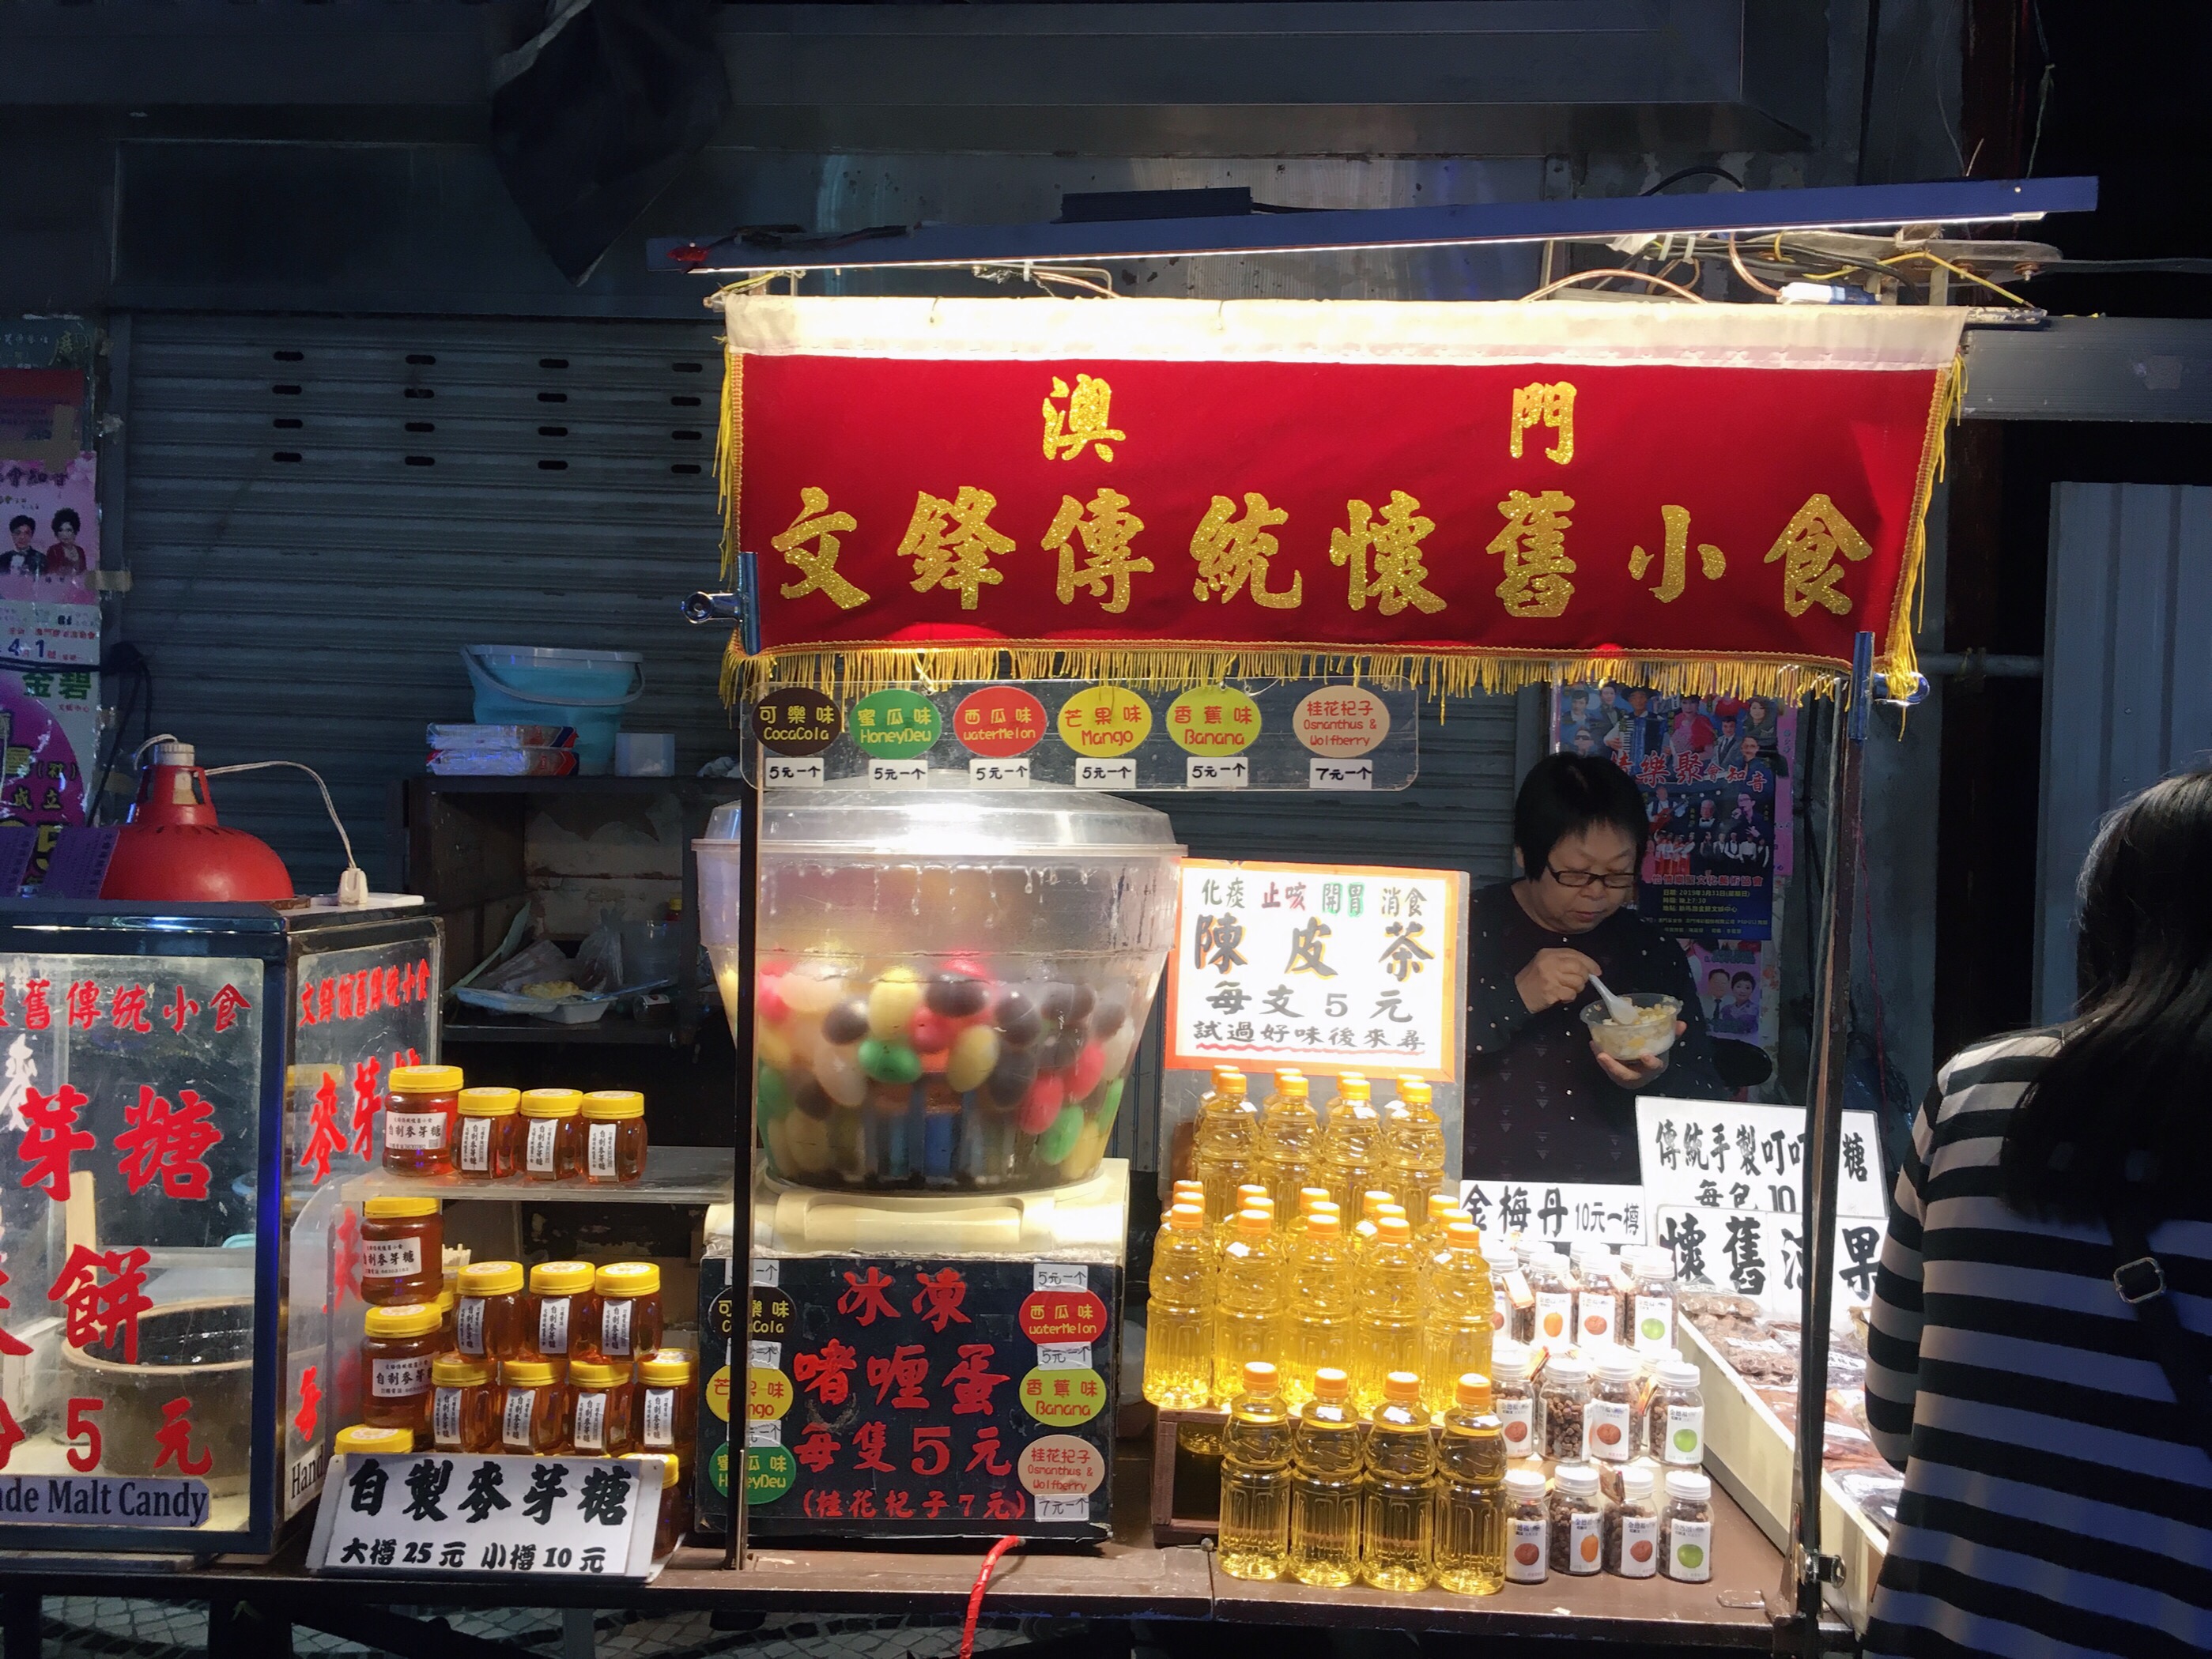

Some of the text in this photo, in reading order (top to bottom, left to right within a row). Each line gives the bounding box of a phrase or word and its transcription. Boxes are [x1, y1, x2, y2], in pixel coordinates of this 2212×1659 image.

[1042, 374, 1577, 465] 澳門
[771, 486, 1873, 618] 文鋒傳統懷舊小食
[760, 706, 834, 724] 可樂味
[858, 708, 931, 726] 蜜瓜味
[964, 707, 1032, 725] 西瓜味
[1065, 704, 1142, 728] 芒果味
[1174, 705, 1253, 725] 香蕉味
[764, 727, 829, 740] CocaCola
[964, 727, 1036, 740] waterMelon
[1303, 719, 1377, 730] Osmanthus &
[860, 727, 931, 744] HoneyDew
[1081, 730, 1134, 746] Mango
[1185, 729, 1245, 745] Banana
[1310, 734, 1371, 747] Wolfberry
[1202, 877, 1427, 918] 化痰 止咳 開胃 消食
[1195, 912, 1435, 982] 陳皮茶
[1206, 980, 1414, 1023] 每支5元
[1193, 1020, 1425, 1051] 試過好味後來尋
[17, 1084, 223, 1202] 芽糖
[1463, 1183, 1568, 1238] 金梅丹
[837, 1266, 973, 1334] 冰凍
[1030, 1304, 1093, 1319] 西瓜味
[723, 1319, 784, 1333] CCola
[1029, 1323, 1097, 1335] waterMelon
[793, 1337, 1012, 1416] 啫喱蛋
[1026, 1378, 1098, 1398] 香蕉味
[1036, 1401, 1091, 1416] Banana
[794, 1420, 1013, 1476] 每隻5元
[1028, 1464, 1093, 1477] Osmanthus &
[1032, 1478, 1087, 1492] Wolfberry
[47, 1479, 112, 1514] Malt
[119, 1481, 209, 1527] Candy
